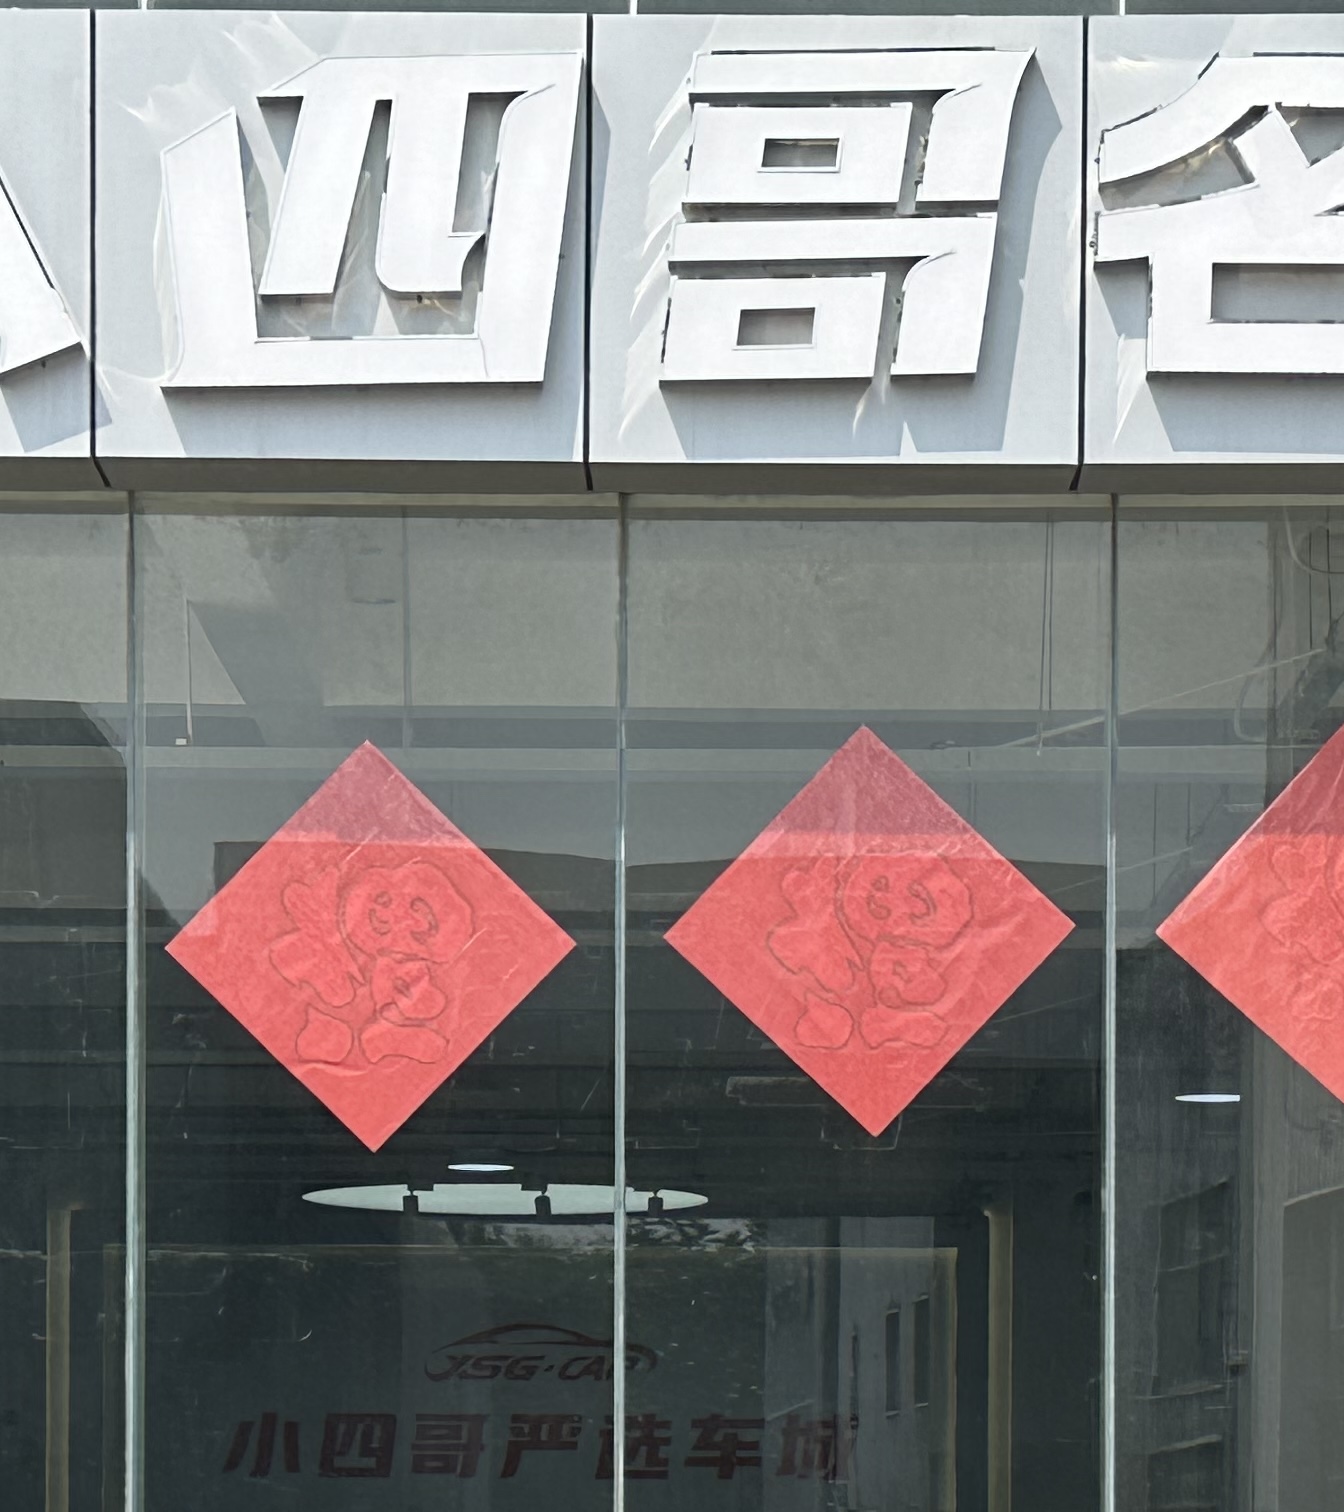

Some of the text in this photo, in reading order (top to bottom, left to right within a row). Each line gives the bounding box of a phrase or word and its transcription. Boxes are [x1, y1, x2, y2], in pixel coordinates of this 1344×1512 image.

[222, 1410, 860, 1480] 小四哥严选车城
